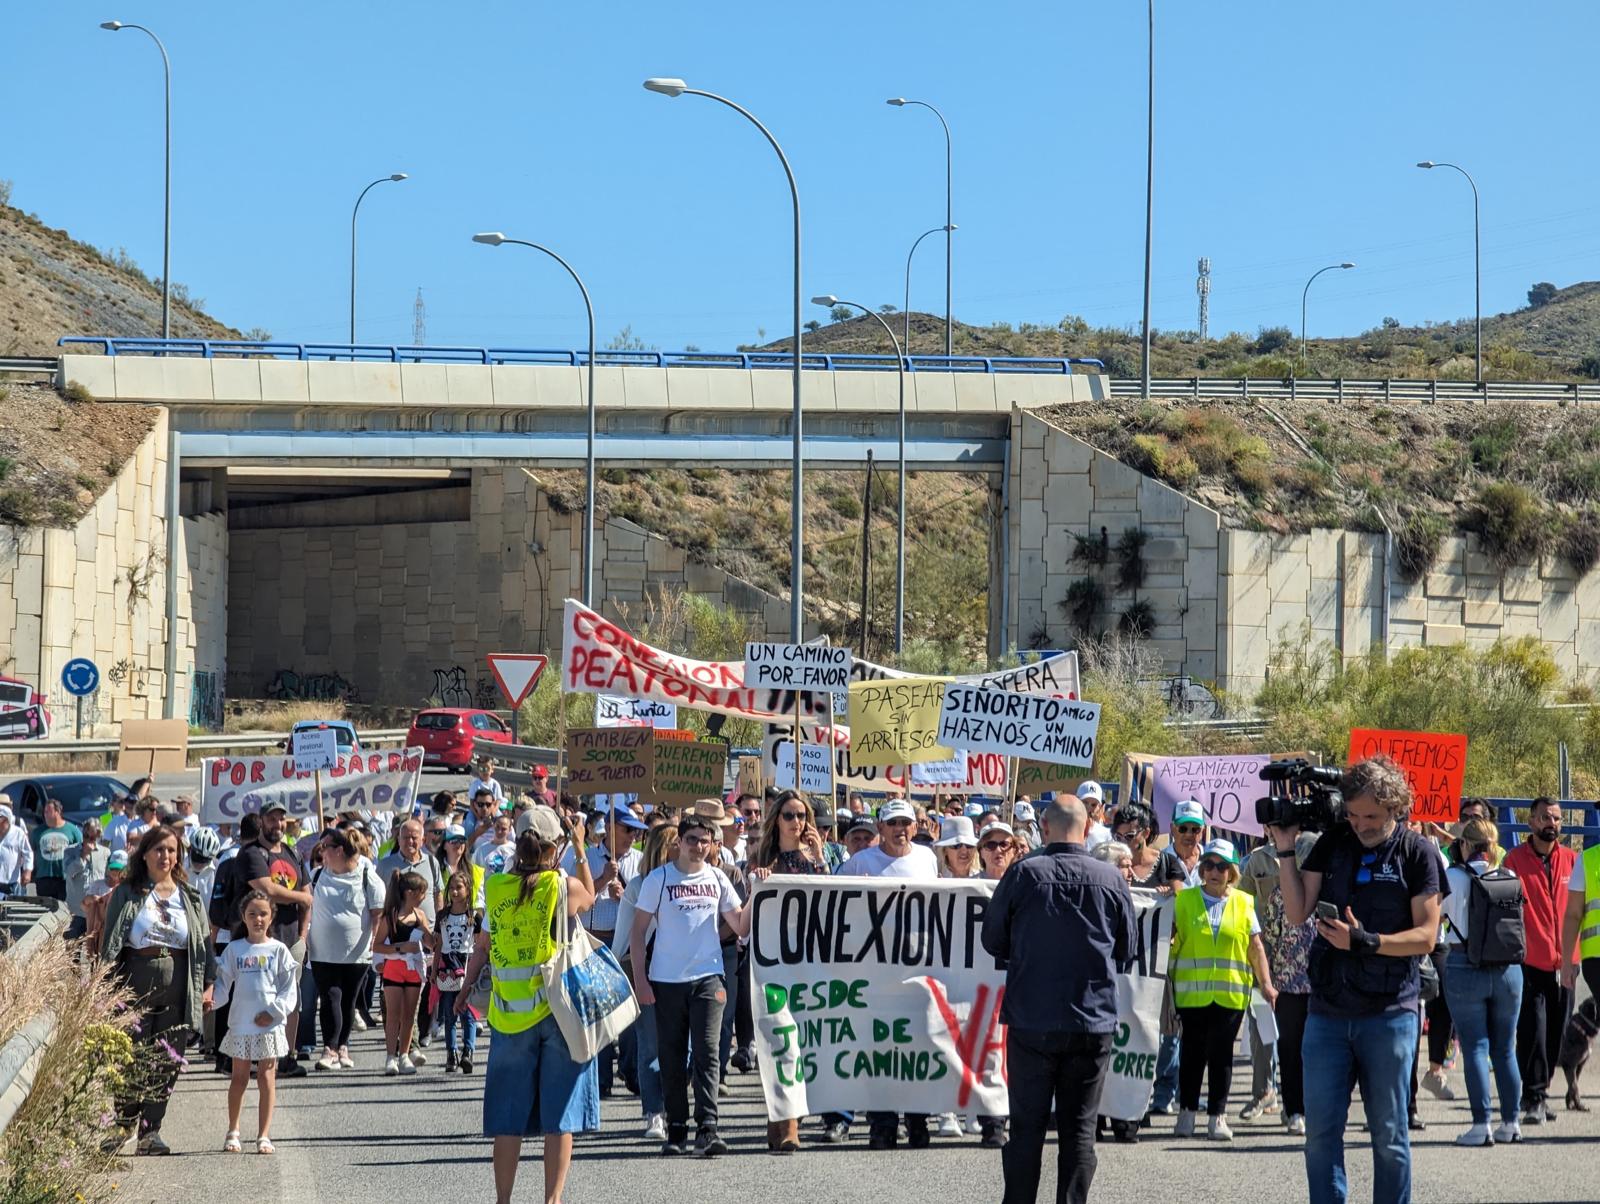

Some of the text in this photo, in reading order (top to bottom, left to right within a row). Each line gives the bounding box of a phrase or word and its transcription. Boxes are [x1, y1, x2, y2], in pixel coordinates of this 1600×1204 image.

[750, 644, 846, 664] UN CAMINO
[759, 664, 794, 685] POR
[803, 667, 848, 687] FAVOR
[1060, 706, 1095, 722] AMIGO
[943, 716, 1094, 759] HAZNOS UN CAMINO
[582, 750, 636, 763] SOMOS
[211, 759, 266, 786] POR
[569, 768, 594, 783] DEL
[655, 762, 713, 781] AMINAR
[1160, 758, 1259, 778] AISLAMIENTO
[1178, 777, 1250, 793] PEATONAL
[1429, 773, 1449, 793] LA
[1409, 794, 1453, 817] ONDA
[764, 979, 869, 1014] DESDE
[771, 1016, 913, 1057] JUNTA DE
[1110, 1049, 1157, 1080] ORRE
